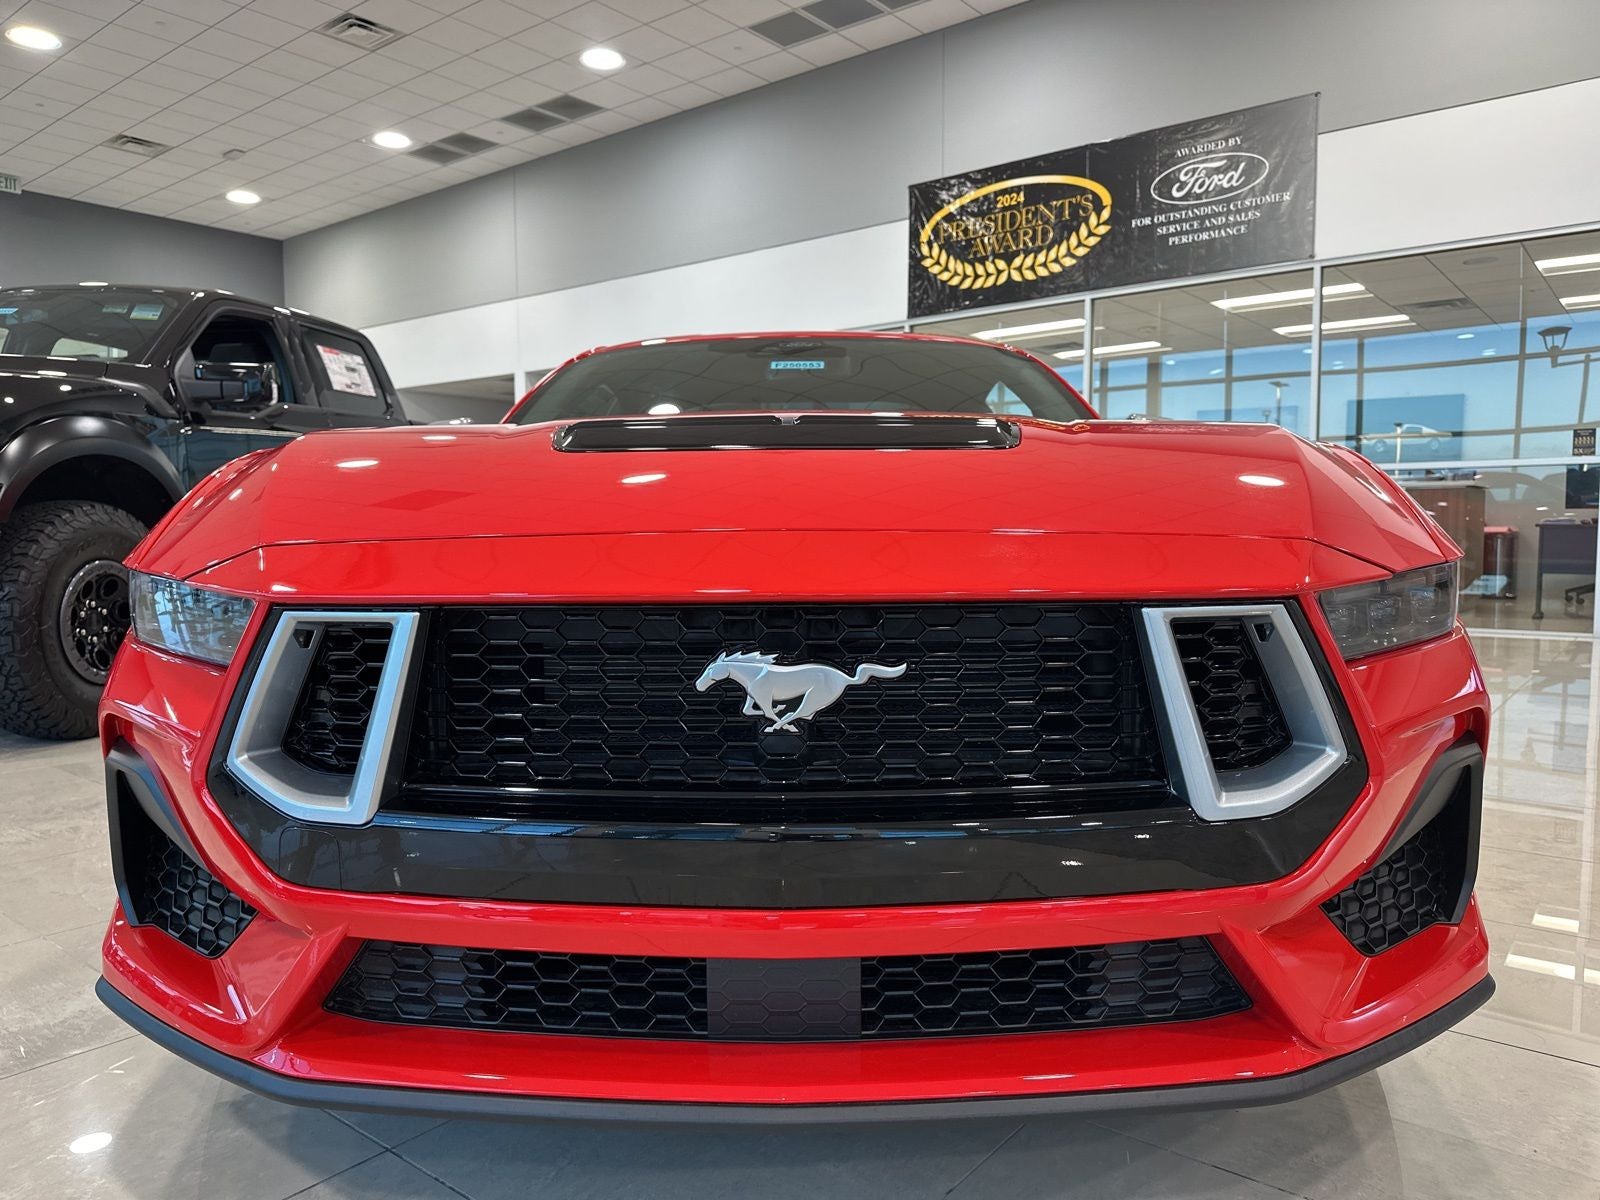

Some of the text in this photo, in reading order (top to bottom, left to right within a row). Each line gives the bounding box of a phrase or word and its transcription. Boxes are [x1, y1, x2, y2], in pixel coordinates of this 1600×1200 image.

[1175, 135, 1243, 158] AWARDED BY
[1171, 159, 1246, 198] Ford
[996, 192, 1025, 208] 2024
[1131, 191, 1291, 229] FOR OUTSTANDING CUSTOMER
[937, 194, 1093, 245] PRESIDENT'S
[1156, 209, 1261, 236] SERVICE AND SALES
[1168, 224, 1249, 246] PERFORMANCE
[968, 224, 1054, 259] AWARD
